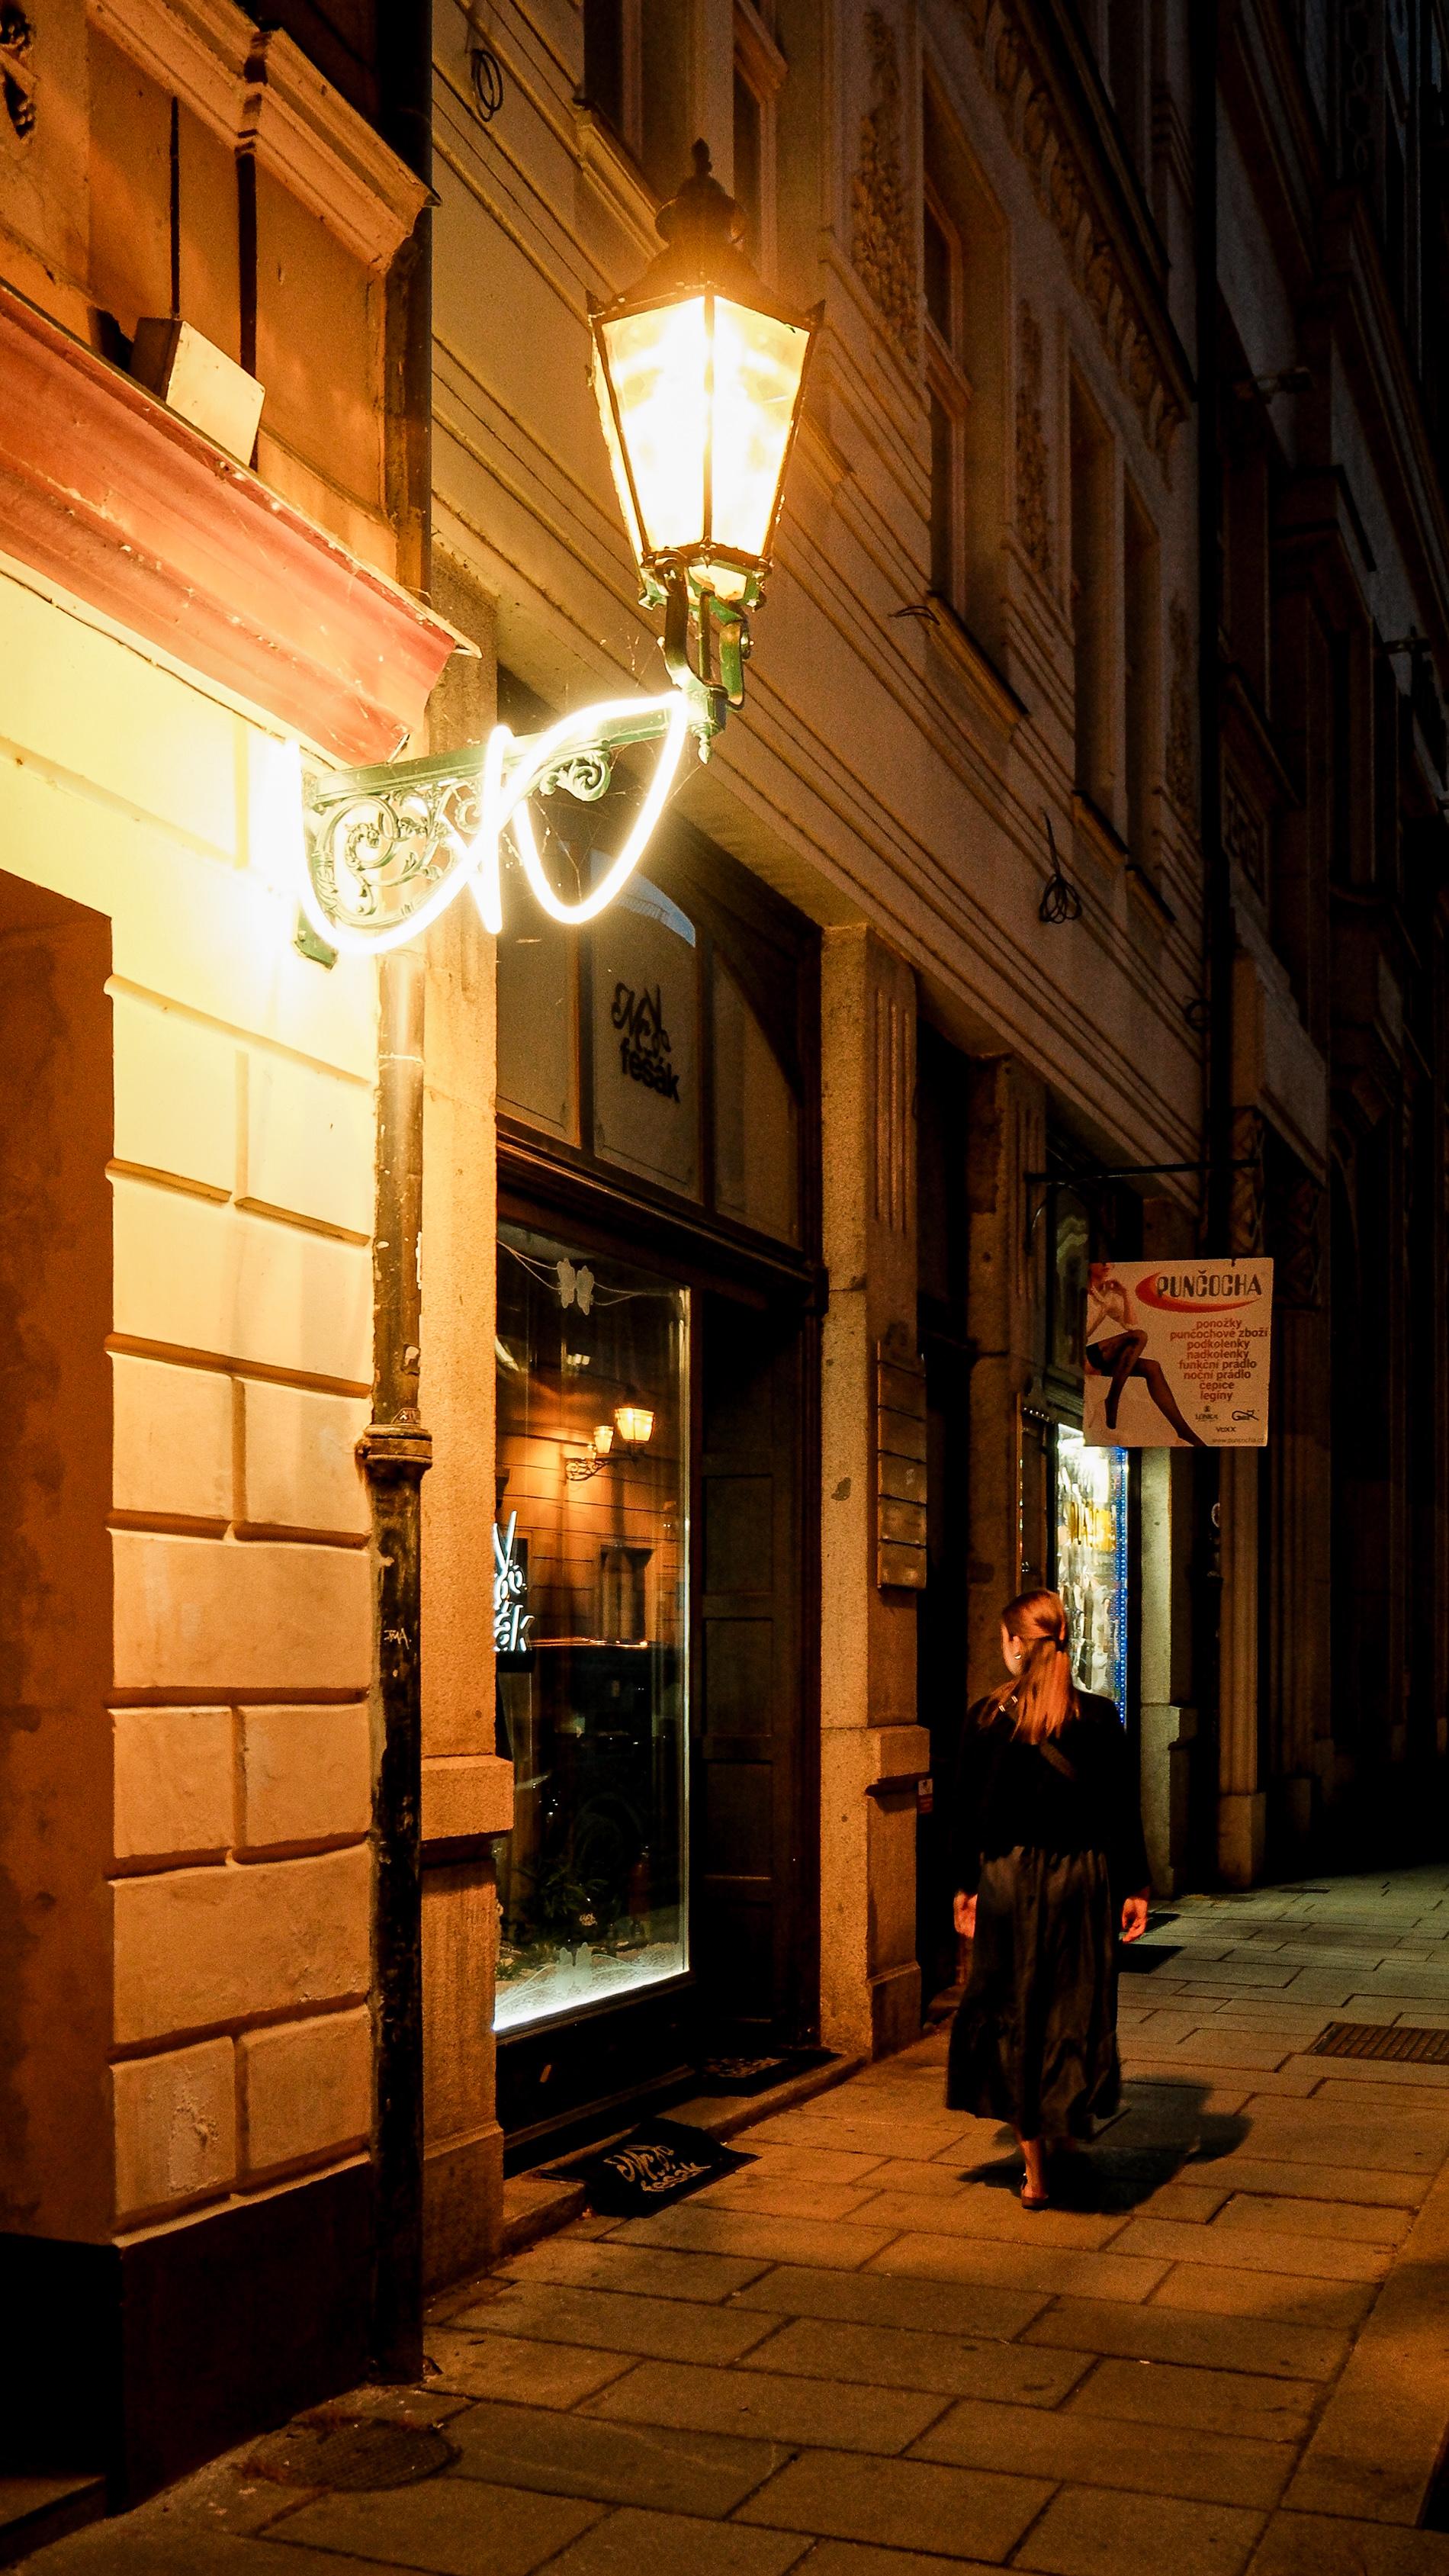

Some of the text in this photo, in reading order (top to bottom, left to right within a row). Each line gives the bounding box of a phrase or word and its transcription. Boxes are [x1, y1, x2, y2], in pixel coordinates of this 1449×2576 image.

[1156, 1270, 1262, 1298] PUNČOCHA
[1196, 1318, 1242, 1330] ponožky
[1170, 1327, 1268, 1341] punčochové zboží
[1187, 1339, 1250, 1351] podkolenky
[1187, 1349, 1249, 1360] nadkolenky
[1178, 1358, 1257, 1370] funkční prádlo
[1184, 1369, 1251, 1381] noční prádlo
[1199, 1380, 1235, 1391] čepice
